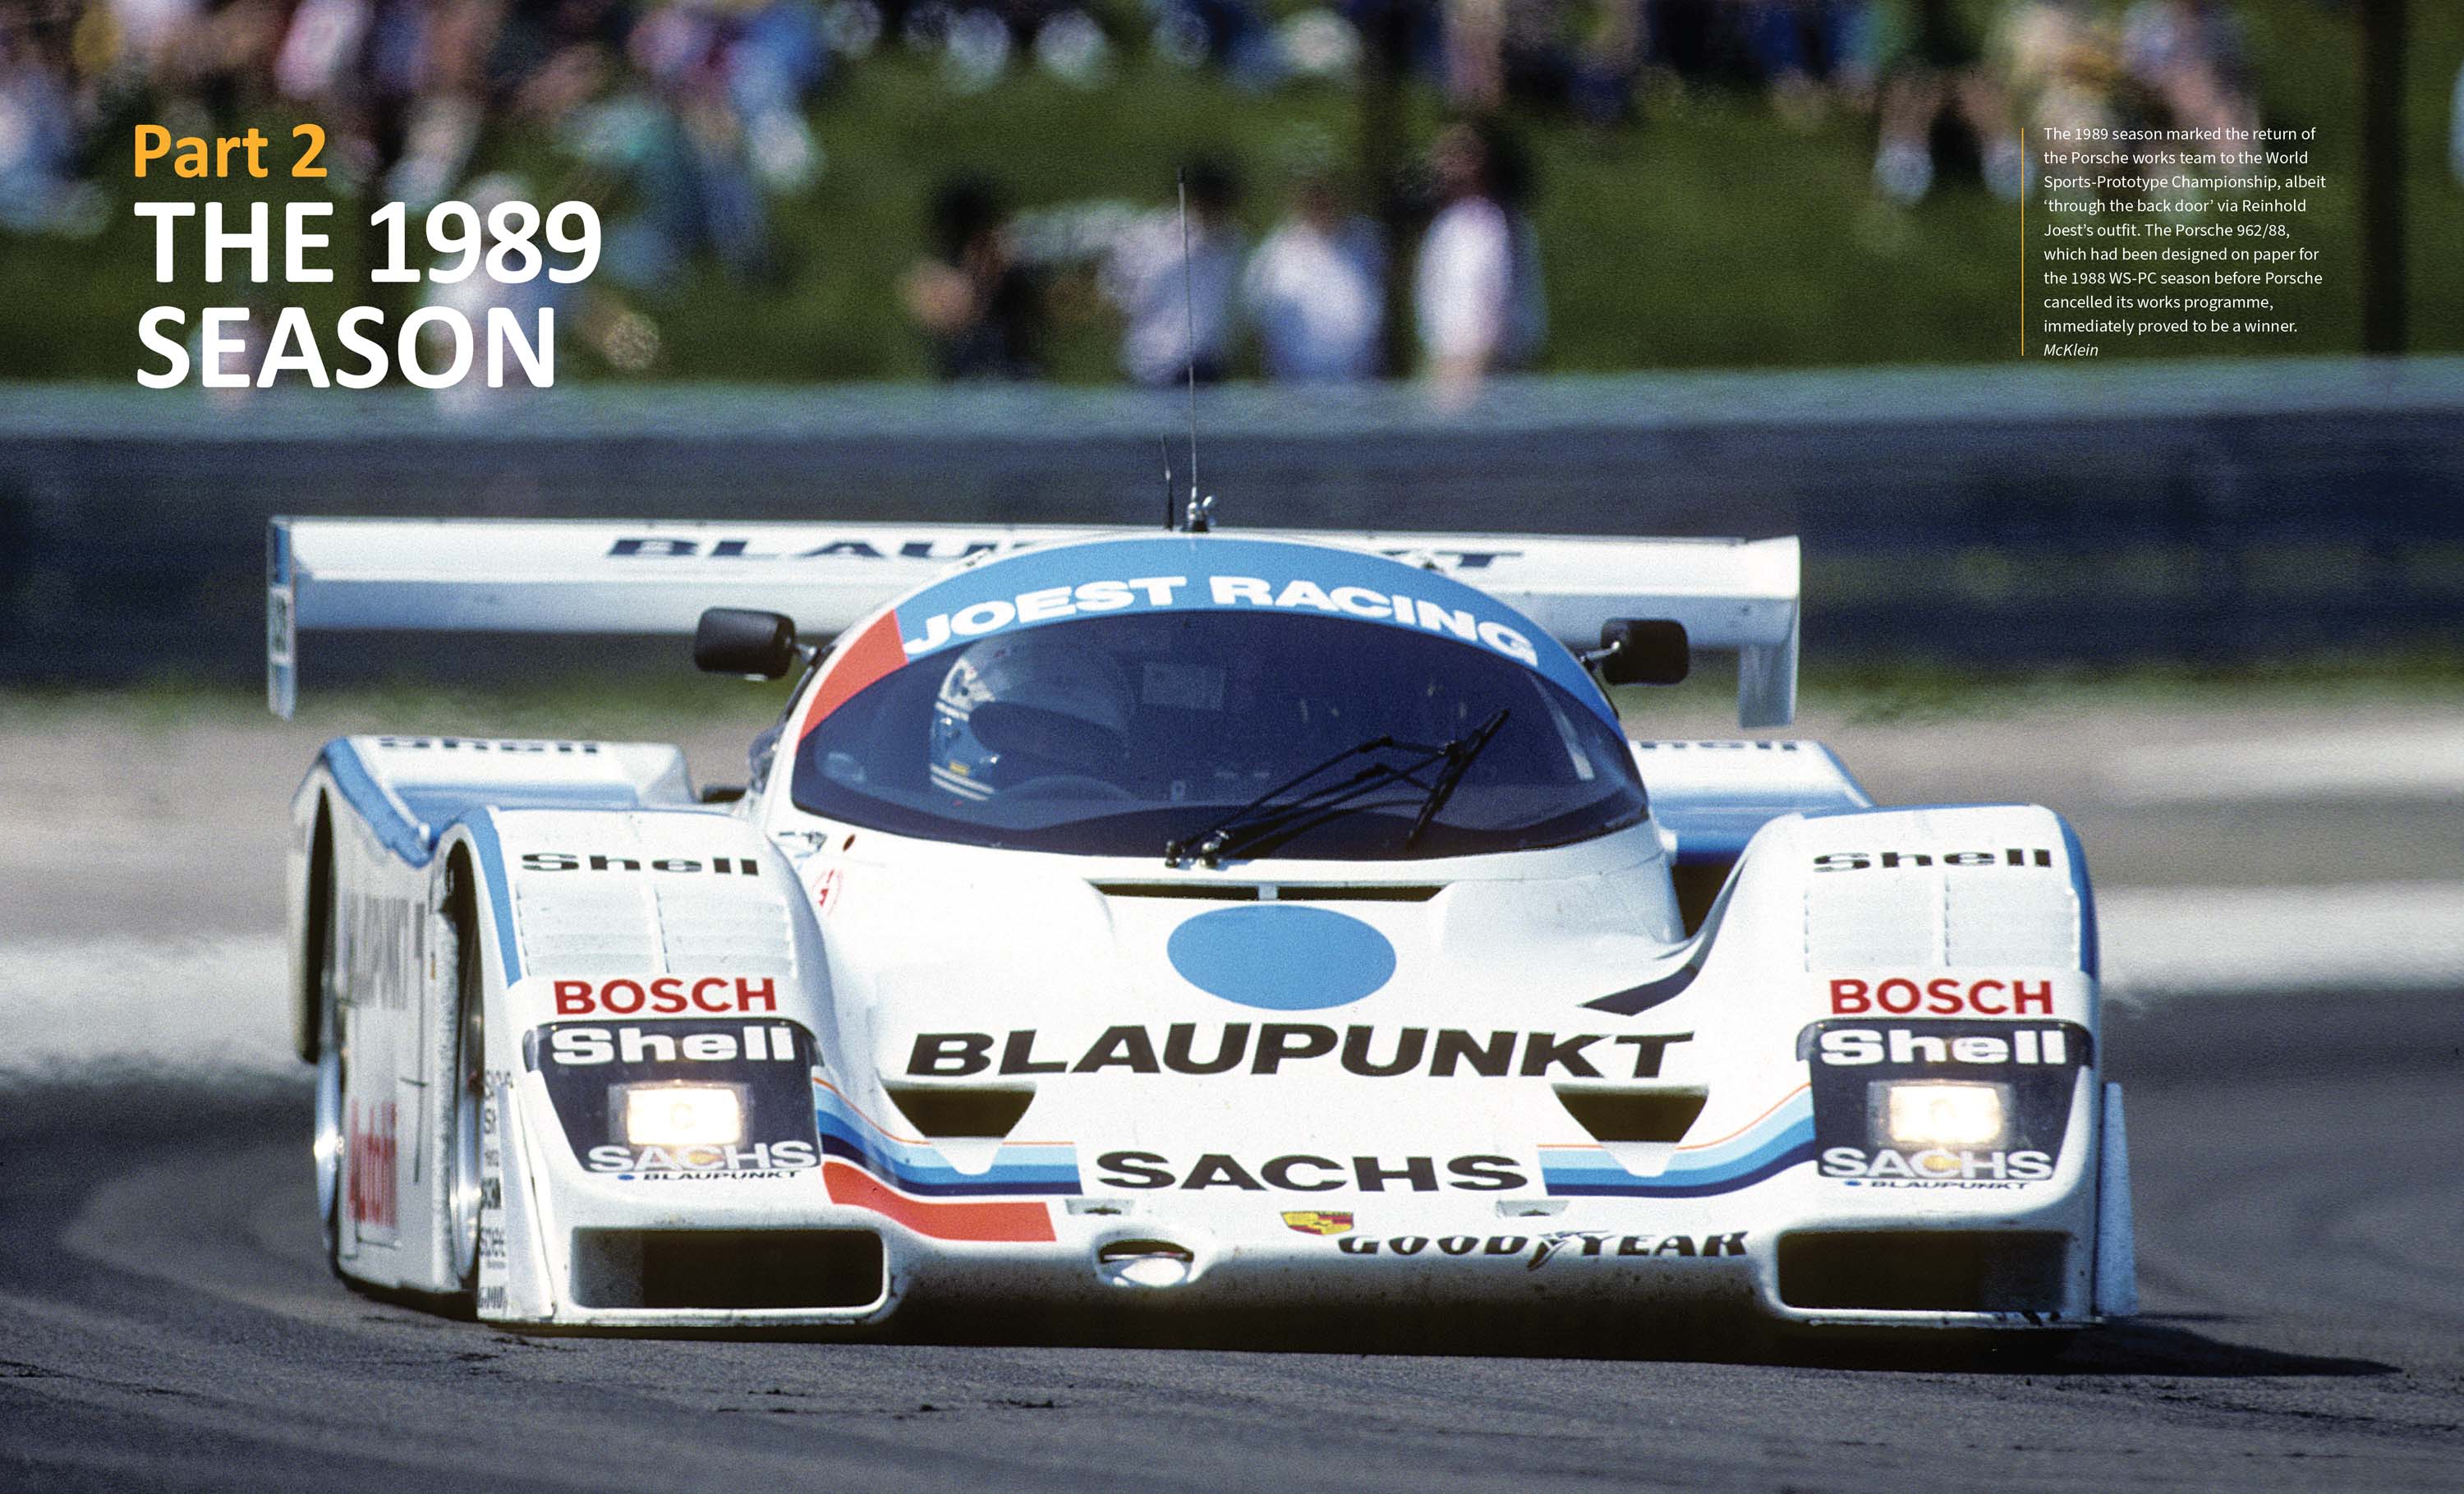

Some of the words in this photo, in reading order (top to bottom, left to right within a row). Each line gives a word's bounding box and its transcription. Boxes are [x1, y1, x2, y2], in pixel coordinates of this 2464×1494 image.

[907, 575, 1187, 656] JOEST
[1209, 575, 1539, 667] RACING
[522, 853, 759, 876] Shell
[1814, 848, 2053, 872] Shell
[554, 977, 776, 1015] BOSCH
[1830, 978, 2054, 1016] BOSCH
[551, 1025, 795, 1066] Shell
[906, 1022, 1694, 1078] BLAUPUNKT
[1820, 1028, 2066, 1066] Shell
[588, 1140, 817, 1172] SACHS
[1096, 1150, 1528, 1193] SACHS
[1822, 1147, 2053, 1180] SACHS
[643, 1170, 801, 1181] BLAUPUNKT
[1871, 1180, 2030, 1189] BLAUPUNKT
